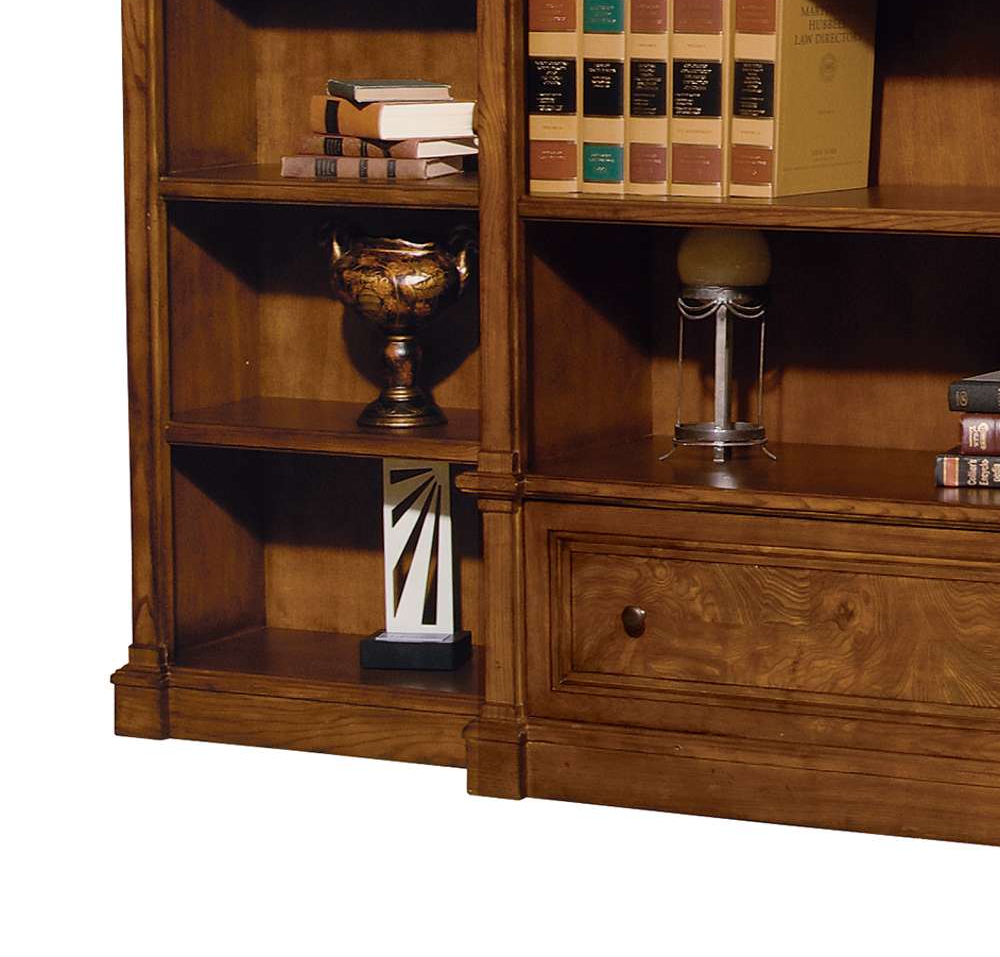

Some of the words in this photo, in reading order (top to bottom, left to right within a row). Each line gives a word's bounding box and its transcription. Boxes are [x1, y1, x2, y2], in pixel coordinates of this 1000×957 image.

[793, 34, 813, 46] LAW
[815, 32, 866, 45] DIRECTOR
[966, 459, 978, 486] Collier's
